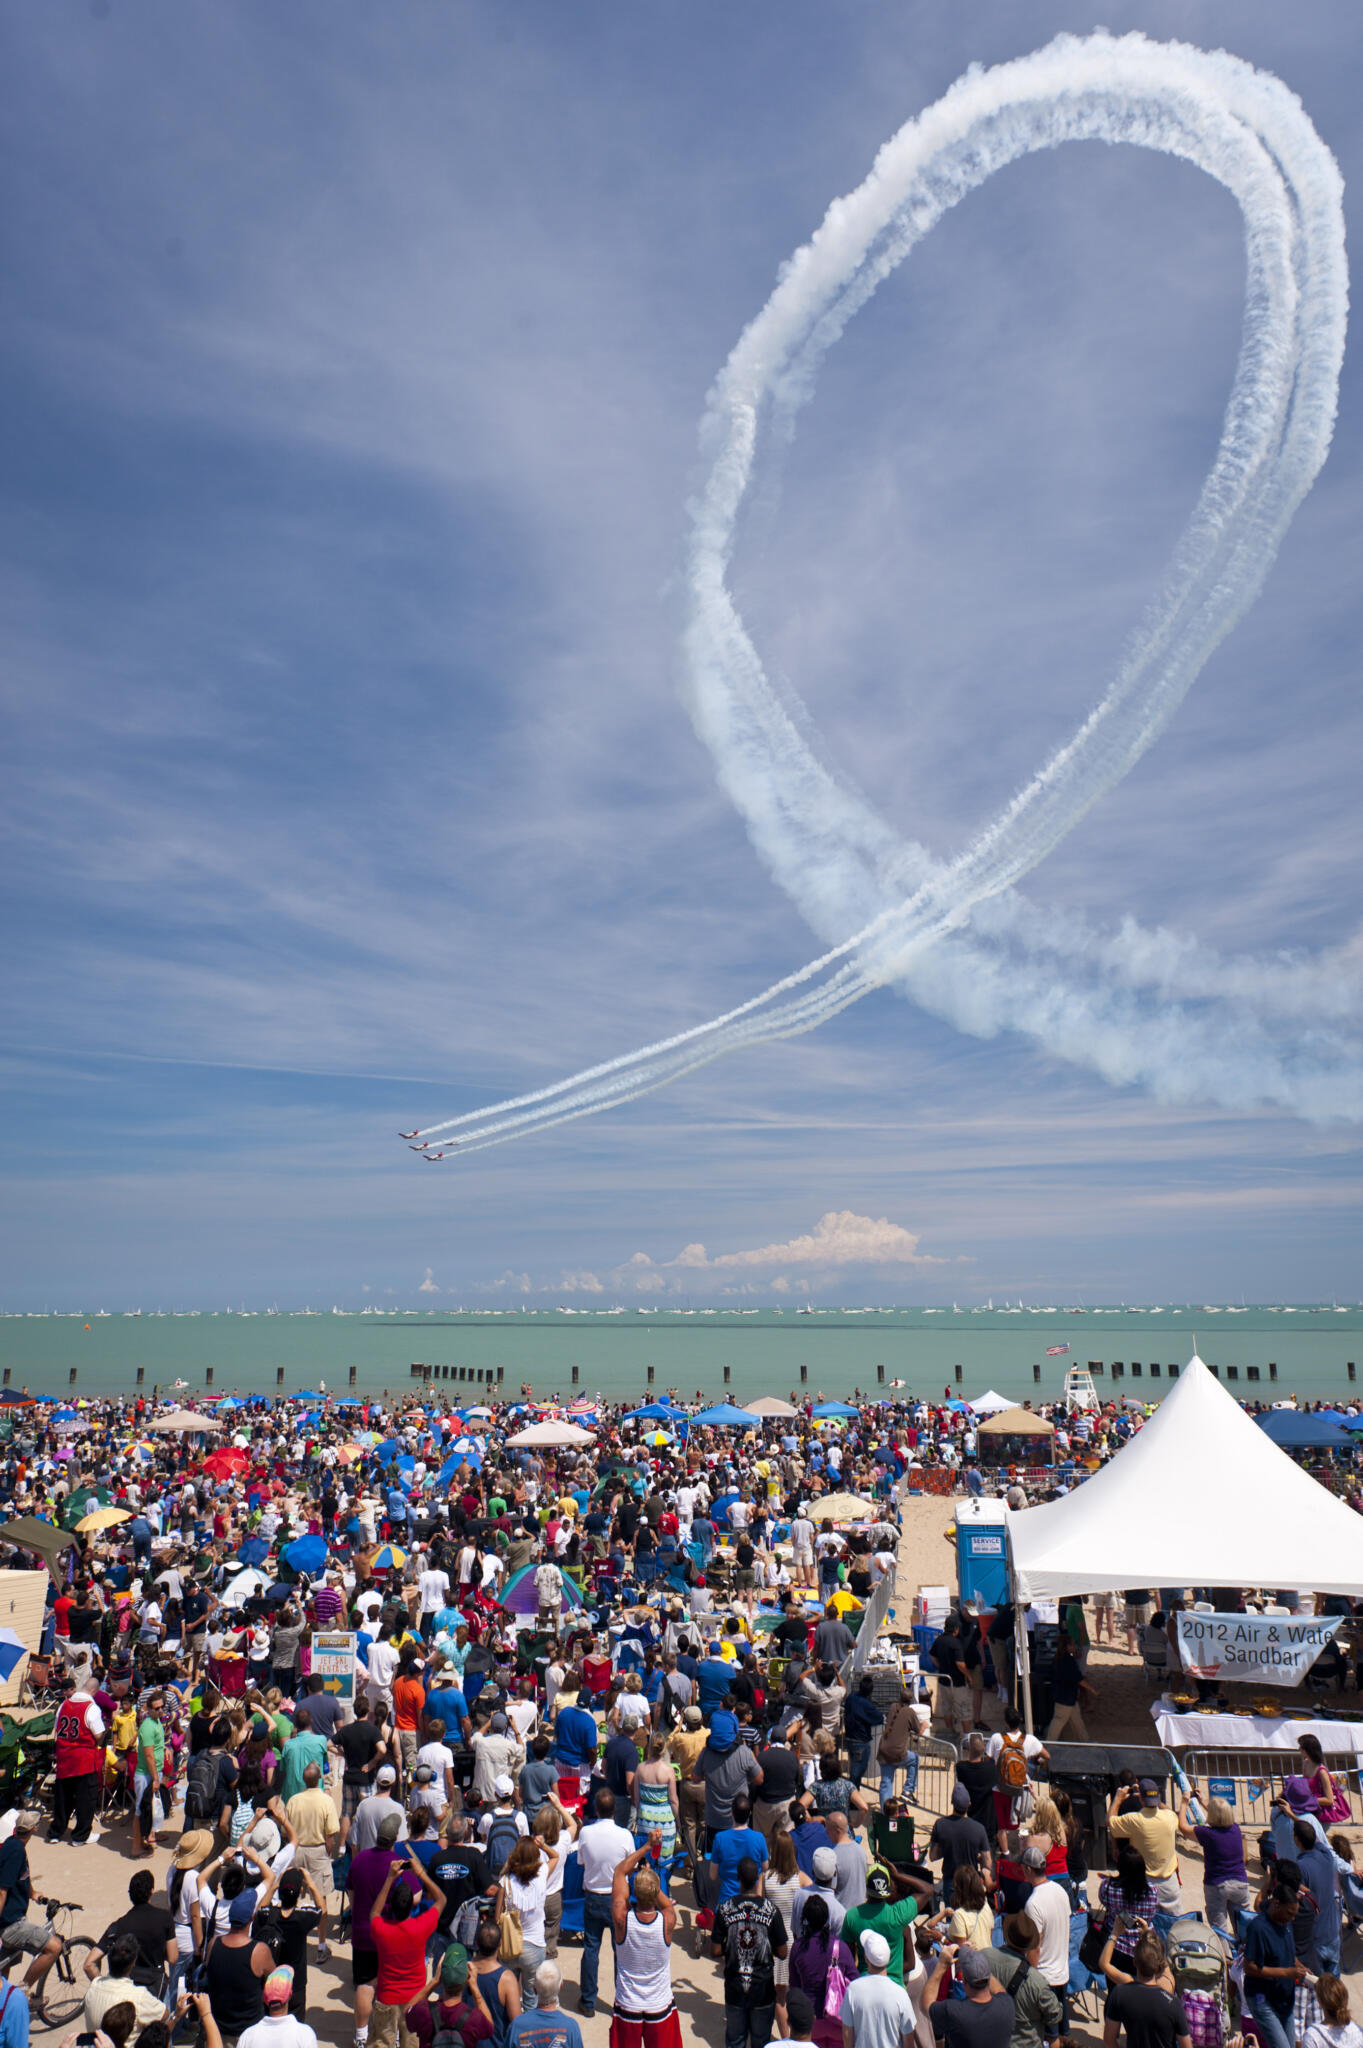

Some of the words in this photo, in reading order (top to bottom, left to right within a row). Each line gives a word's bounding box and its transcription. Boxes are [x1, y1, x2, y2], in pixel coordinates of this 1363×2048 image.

[1183, 1621, 1228, 1641] 2012
[1234, 1625, 1260, 1643] Air
[1267, 1625, 1280, 1643] &
[320, 1656, 331, 1665] JET
[335, 1656, 347, 1665] SKI
[1224, 1644, 1301, 1667] Sandbar
[317, 1664, 349, 1673] RENTALS
[58, 1715, 79, 1739] 23
[749, 1911, 772, 1926] Spirit
